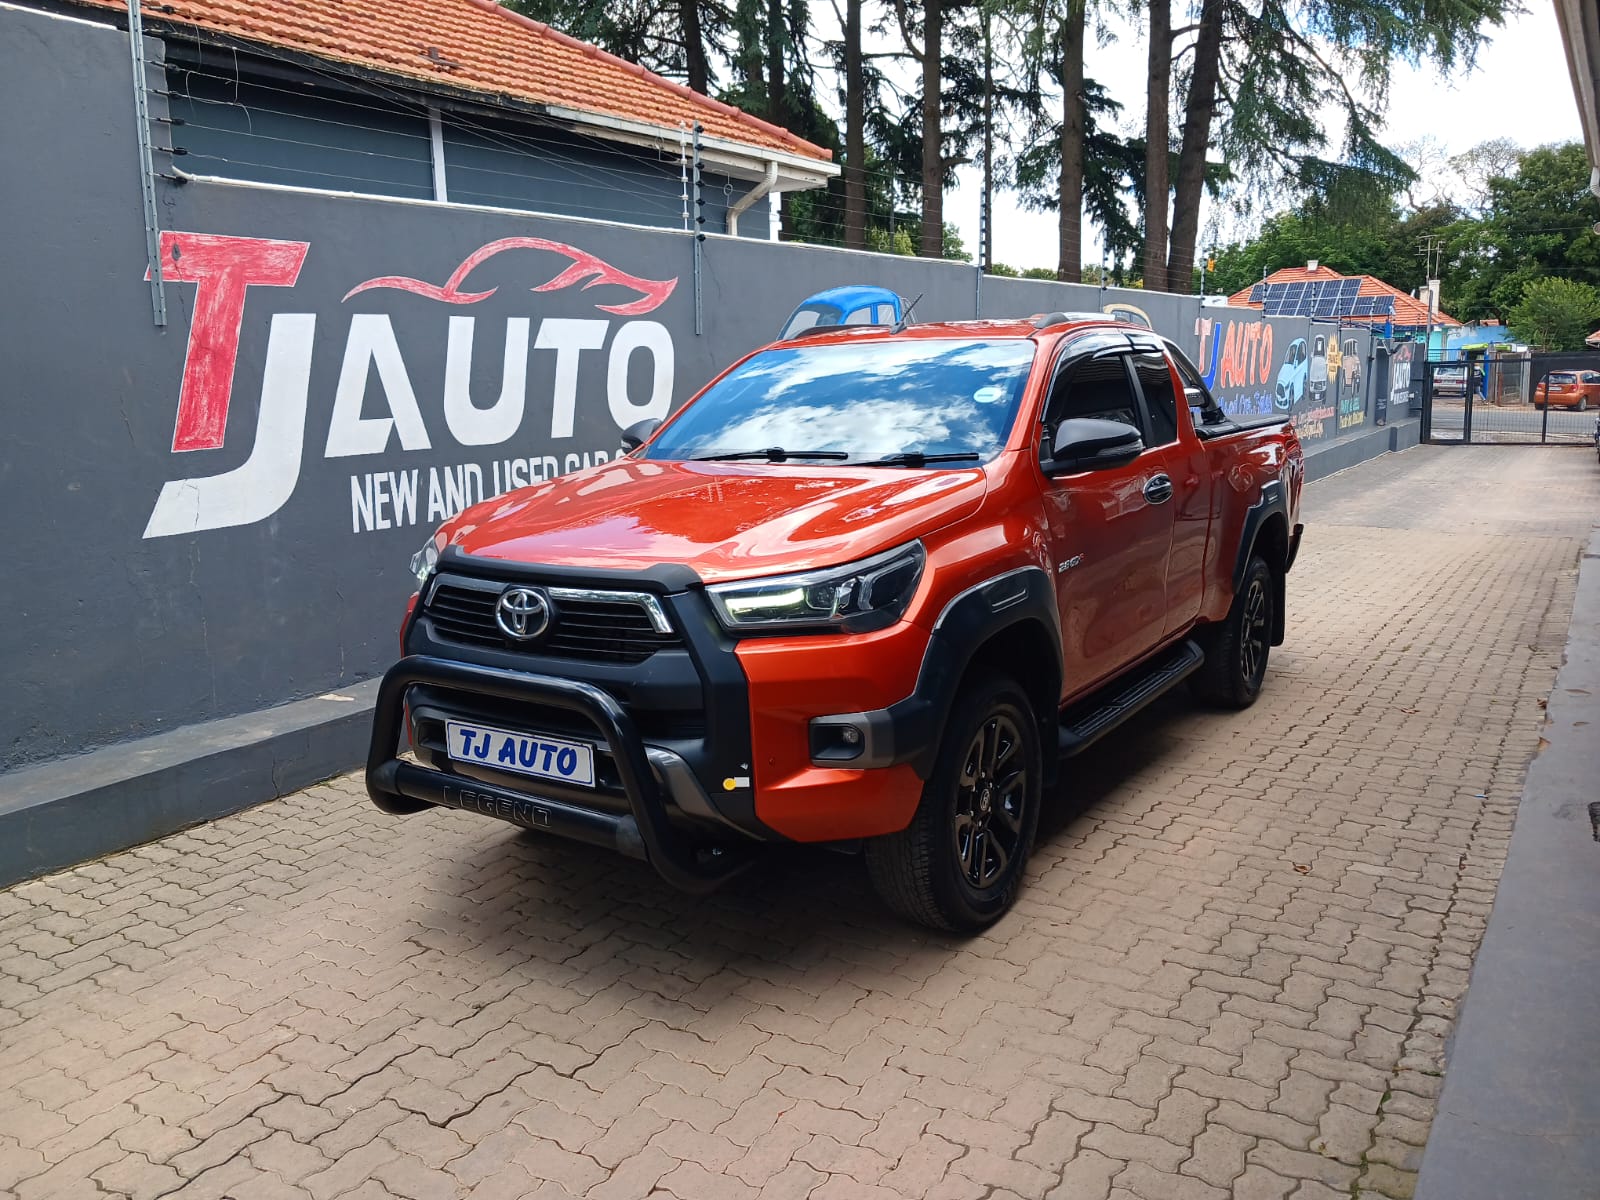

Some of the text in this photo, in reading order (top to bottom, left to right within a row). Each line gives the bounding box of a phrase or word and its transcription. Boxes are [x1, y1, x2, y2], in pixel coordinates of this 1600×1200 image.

[351, 469, 418, 534] NEW
[427, 462, 484, 523] AND
[459, 729, 578, 776] TJ AUTO
[443, 785, 552, 828] LEGEND
